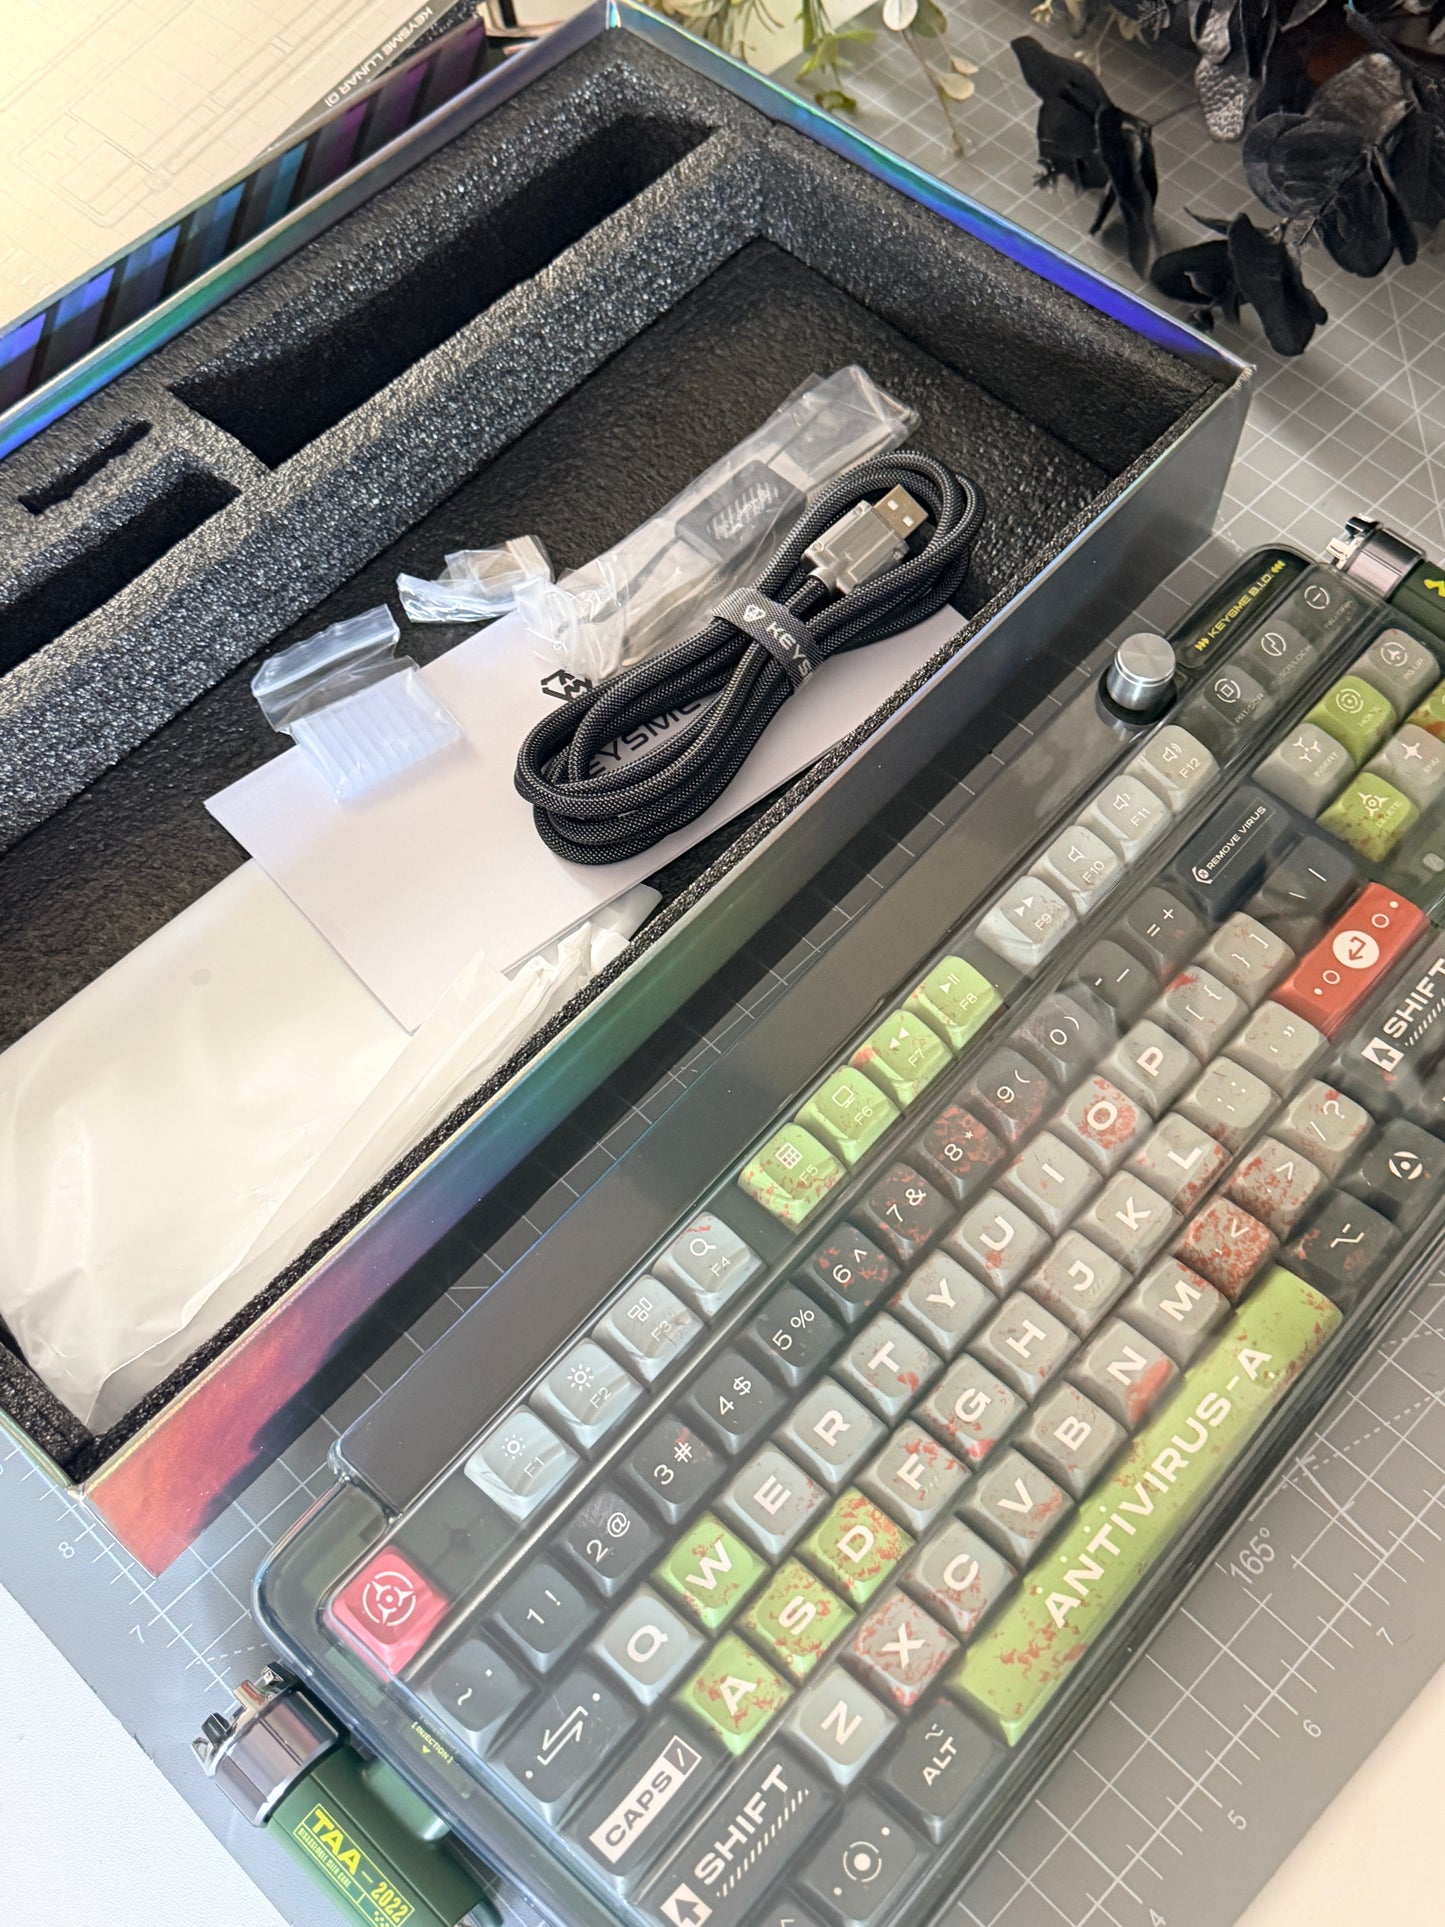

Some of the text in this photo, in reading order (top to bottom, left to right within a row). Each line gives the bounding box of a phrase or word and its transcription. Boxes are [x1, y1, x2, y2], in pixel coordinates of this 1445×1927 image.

[381, 6, 433, 56] KEYSME
[339, 52, 384, 94] LUNAR
[1208, 595, 1252, 638] KEYSME
[1179, 758, 1200, 779] F12
[1130, 806, 1149, 827] F11
[1206, 806, 1266, 870] REMOVE VIRUS
[1082, 860, 1105, 884] F10
[1035, 913, 1052, 931] F9
[959, 992, 978, 1011] F8
[1383, 958, 1445, 1039] SHIFT
[908, 1049, 926, 1068] F7
[1136, 1046, 1164, 1077] P
[997, 1085, 1015, 1104] 9
[1322, 1101, 1345, 1120] ?
[855, 1106, 873, 1126] F6
[1087, 1101, 1117, 1130] O
[944, 1144, 963, 1161] 8
[1167, 1147, 1202, 1170] L
[799, 1164, 818, 1184] F5
[1041, 1163, 1065, 1185] I
[886, 1188, 926, 1222] 7 &
[1115, 1196, 1151, 1230] K
[979, 1215, 1014, 1251] U
[711, 1256, 731, 1277] F4
[833, 1265, 851, 1283] 6
[1068, 1261, 1095, 1291] J
[927, 1278, 956, 1309] Y
[1158, 1280, 1202, 1321] M
[651, 1320, 672, 1342] F3
[772, 1309, 815, 1351] 5 %
[1006, 1319, 1047, 1359] H
[868, 1341, 900, 1373] T
[1106, 1346, 1148, 1386] N
[590, 1387, 612, 1409] F2
[719, 1375, 751, 1415] 4 $
[955, 1387, 991, 1423] G
[813, 1409, 850, 1447] R
[1053, 1416, 1092, 1451] B
[524, 1456, 546, 1478] F1
[654, 1441, 693, 1485] 3 #
[897, 1453, 927, 1491] F
[753, 1475, 792, 1515] E
[998, 1478, 1034, 1514] V
[58, 1541, 75, 1558] 8
[586, 1512, 631, 1562] 2 @
[837, 1525, 874, 1562] D
[686, 1540, 733, 1590] W
[943, 1554, 979, 1591] C
[1227, 1527, 1276, 1584] 165°
[527, 1608, 544, 1624] 1
[778, 1596, 817, 1635] S
[128, 1624, 144, 1643] 7
[627, 1624, 669, 1663] Q
[882, 1623, 926, 1669] X
[1376, 1626, 1394, 1646] 7
[719, 1675, 757, 1717] A
[820, 1700, 863, 1745] Z
[1303, 1719, 1322, 1738] 6
[921, 1737, 957, 1786] ALT
[605, 1770, 673, 1847] CAPS
[694, 1764, 789, 1886] SHIFT
[1227, 1809, 1247, 1831] 5
[312, 1809, 361, 1875] TAA
[371, 1882, 409, 1923] 2022
[1149, 1908, 1166, 1927] 4
